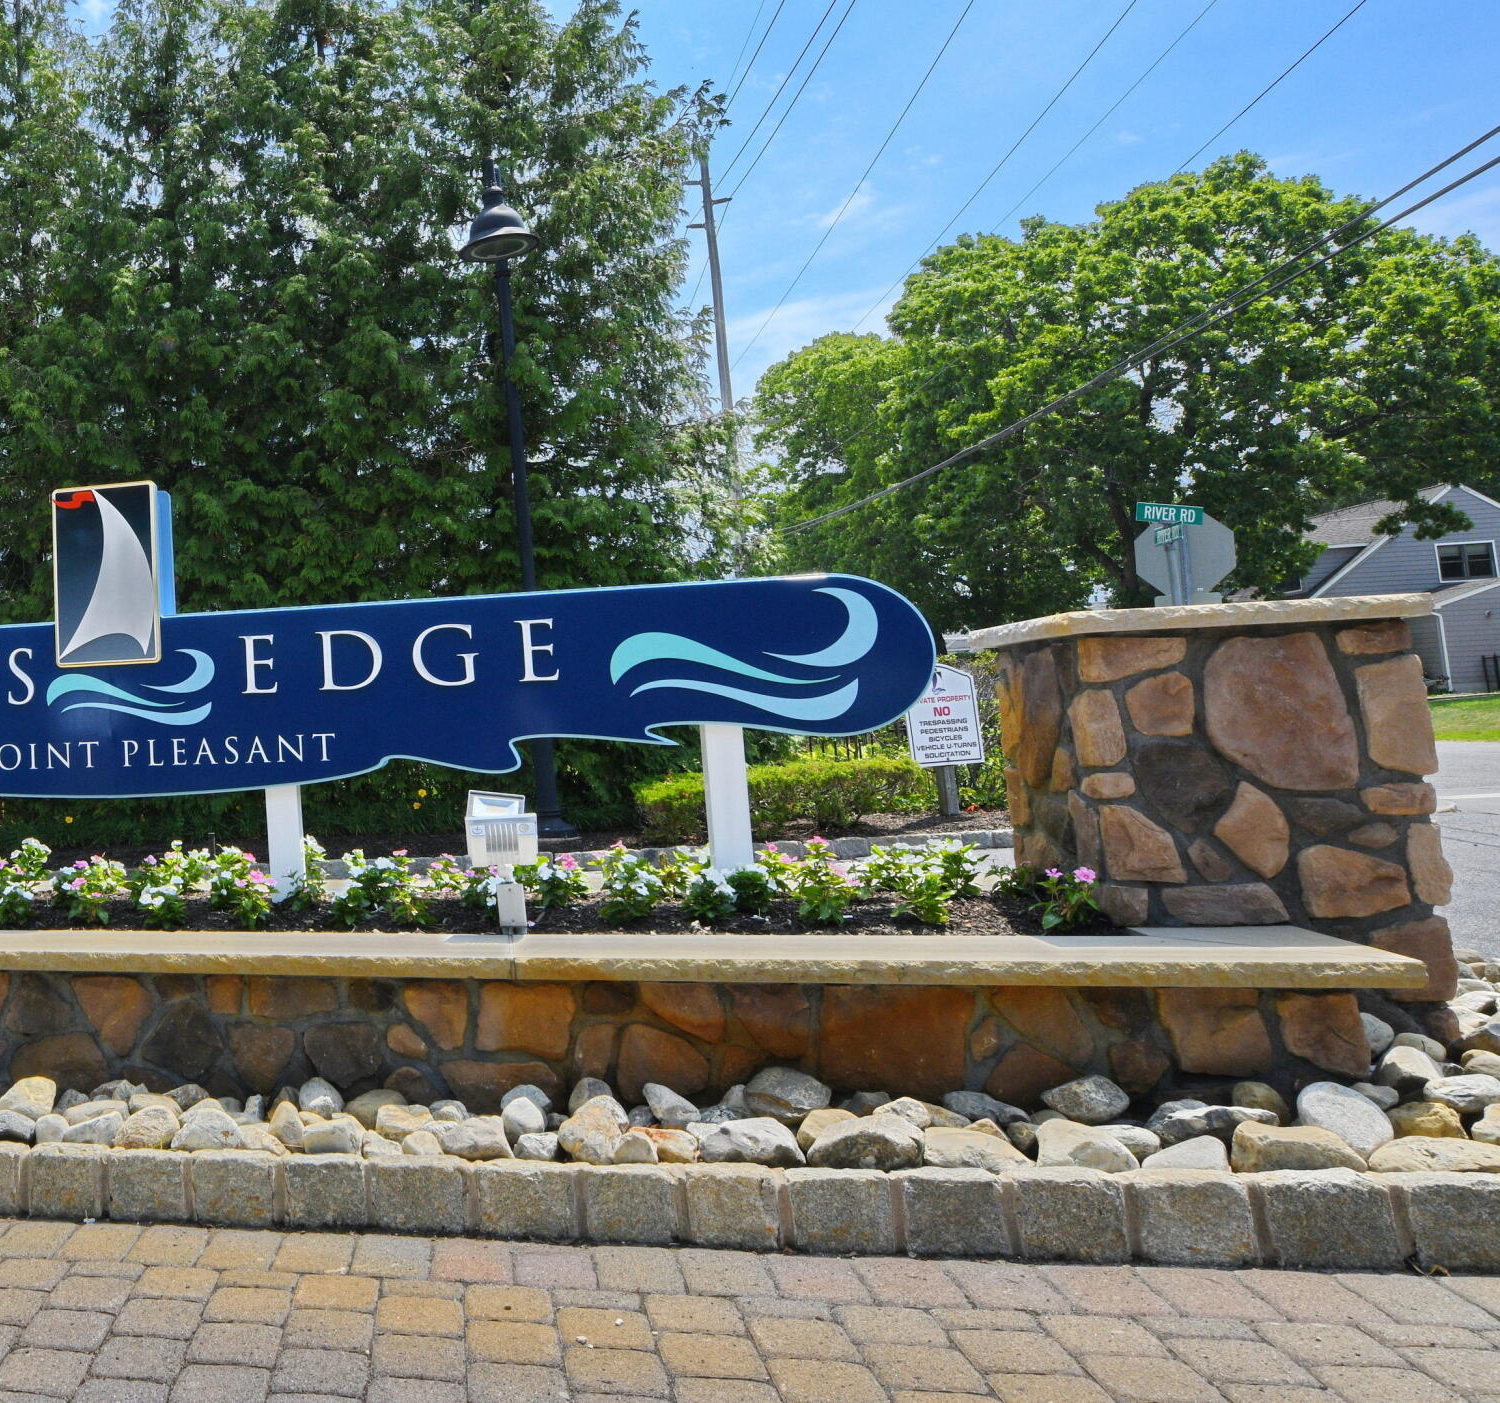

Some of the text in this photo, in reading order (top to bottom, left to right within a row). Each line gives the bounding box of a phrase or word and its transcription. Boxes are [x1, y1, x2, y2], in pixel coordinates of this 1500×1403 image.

[1144, 506, 1196, 523] RIVER RD
[241, 617, 560, 694] EDGE
[933, 706, 951, 717] NO
[919, 718, 968, 726] TRESPASSING
[920, 726, 969, 735] PEDESTRIANS
[122, 732, 336, 767] PLEASANT
[916, 743, 945, 751] VEHICLE
